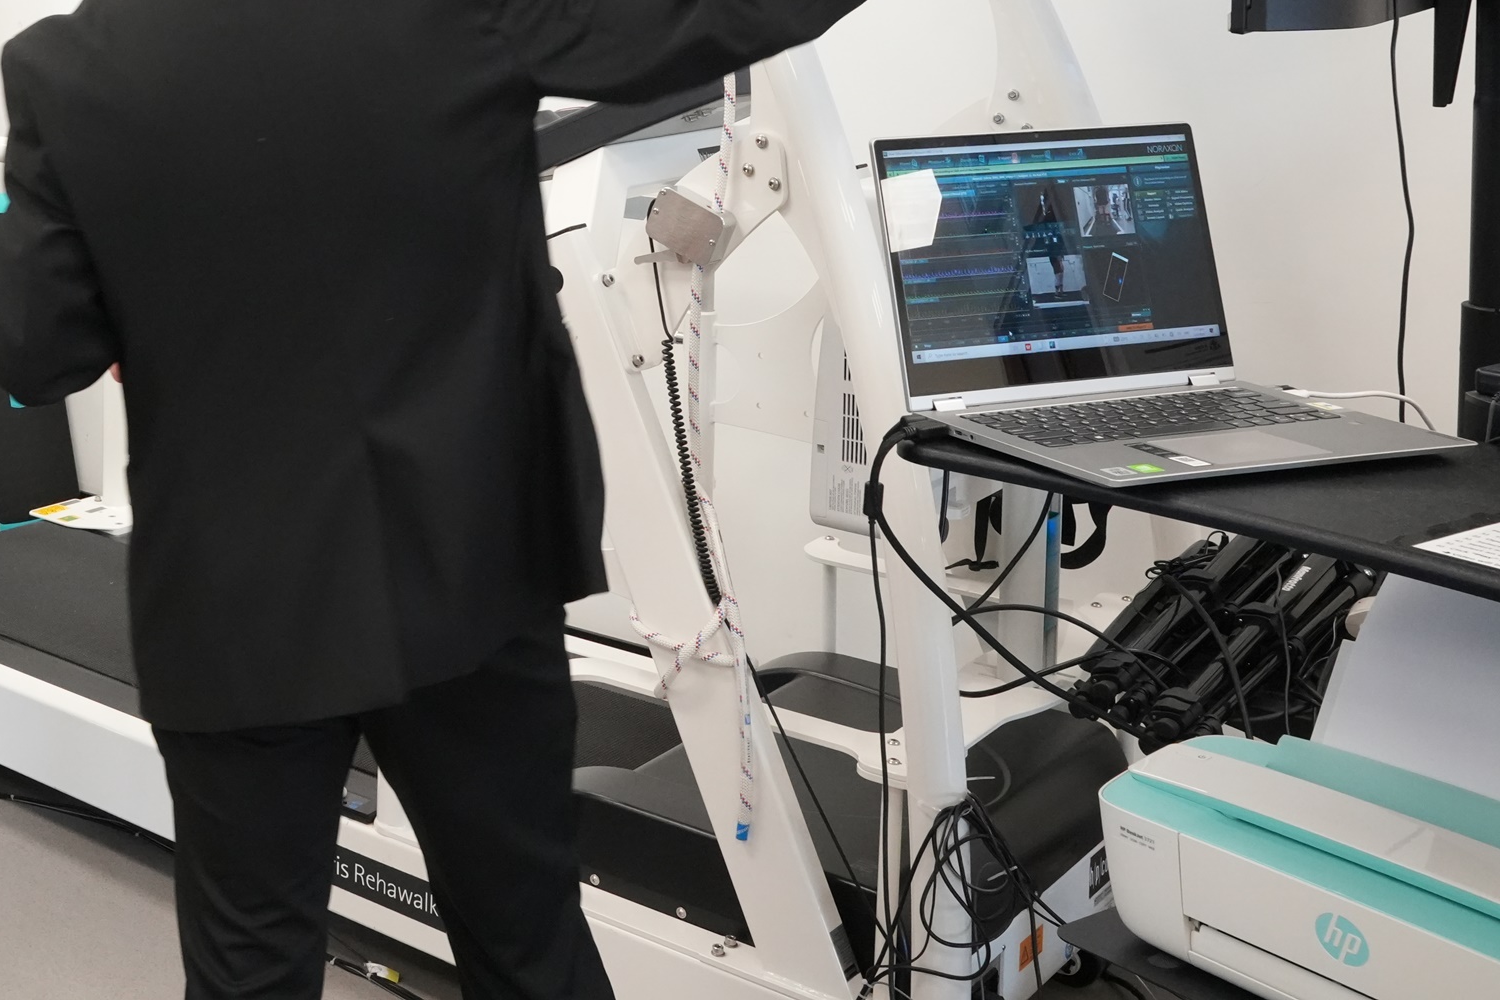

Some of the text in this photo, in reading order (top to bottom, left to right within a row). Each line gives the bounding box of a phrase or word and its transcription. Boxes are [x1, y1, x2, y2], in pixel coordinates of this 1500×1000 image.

[1146, 144, 1183, 154] NORAXON
[333, 855, 439, 917] is Rehawalk
[1320, 913, 1365, 966] hp
